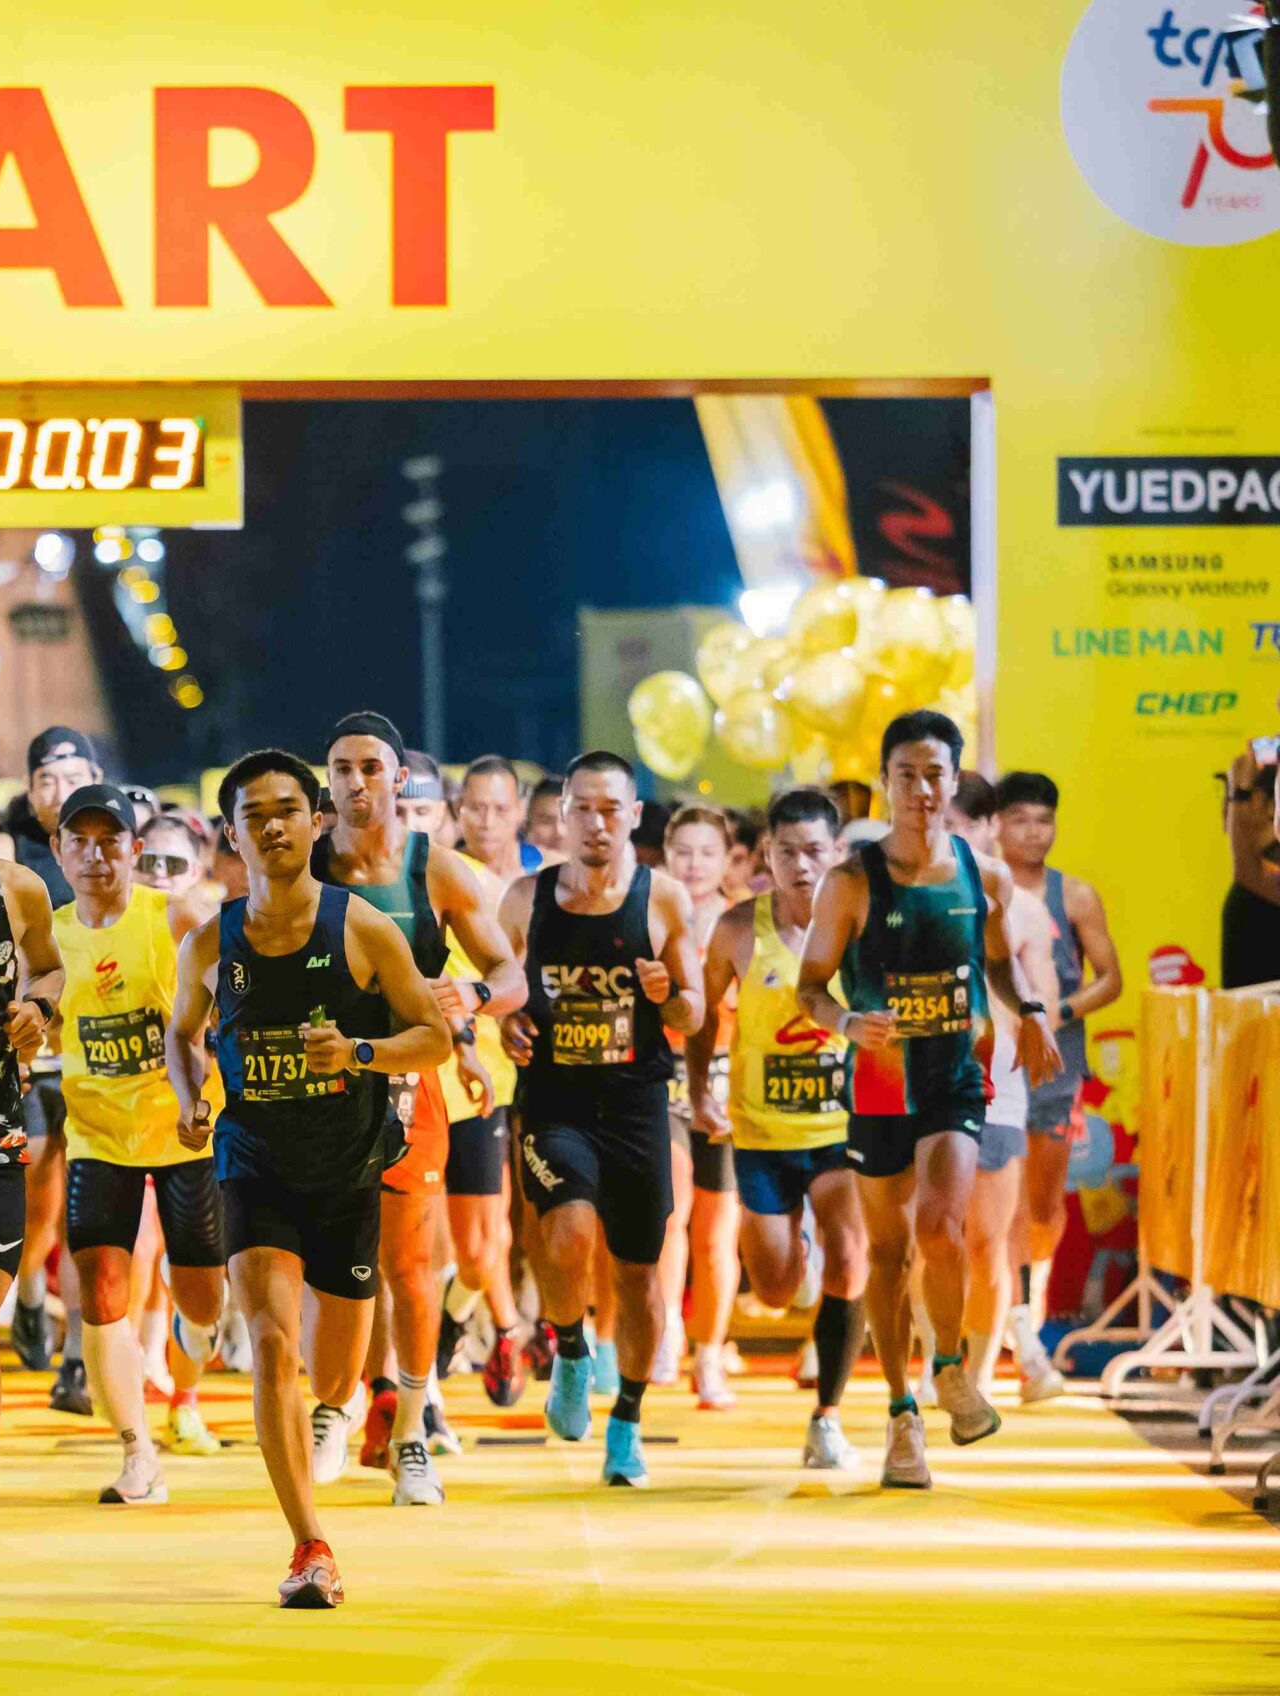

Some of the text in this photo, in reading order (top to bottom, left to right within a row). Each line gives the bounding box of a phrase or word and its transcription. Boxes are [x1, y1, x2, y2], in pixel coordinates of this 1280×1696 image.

[1108, 555, 1224, 572] SAMSUNG
[1107, 579, 1182, 599] Galaxy
[1136, 691, 1238, 715] CHEP
[887, 995, 949, 1020] 22354
[553, 1023, 610, 1048] 22099
[86, 1035, 143, 1063] 22019
[245, 1053, 308, 1082] 21737
[767, 1076, 826, 1100] 21791
